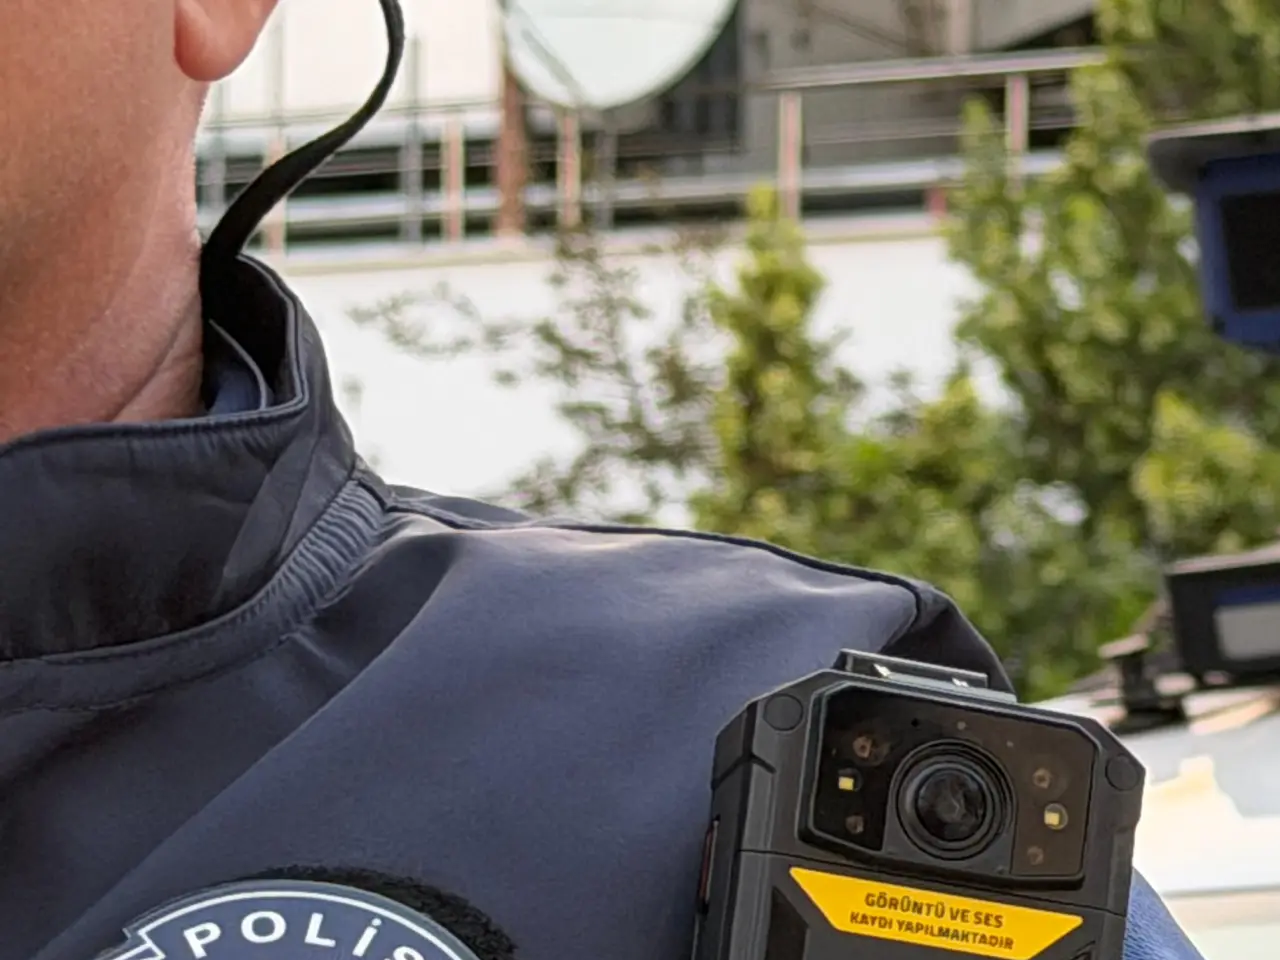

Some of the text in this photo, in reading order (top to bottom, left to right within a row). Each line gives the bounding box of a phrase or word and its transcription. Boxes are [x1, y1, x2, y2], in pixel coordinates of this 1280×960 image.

[864, 891, 1004, 929] GÖRÜNTÜ VE SES
[849, 911, 1014, 951] KAYDI YAPILMAKTADIR
